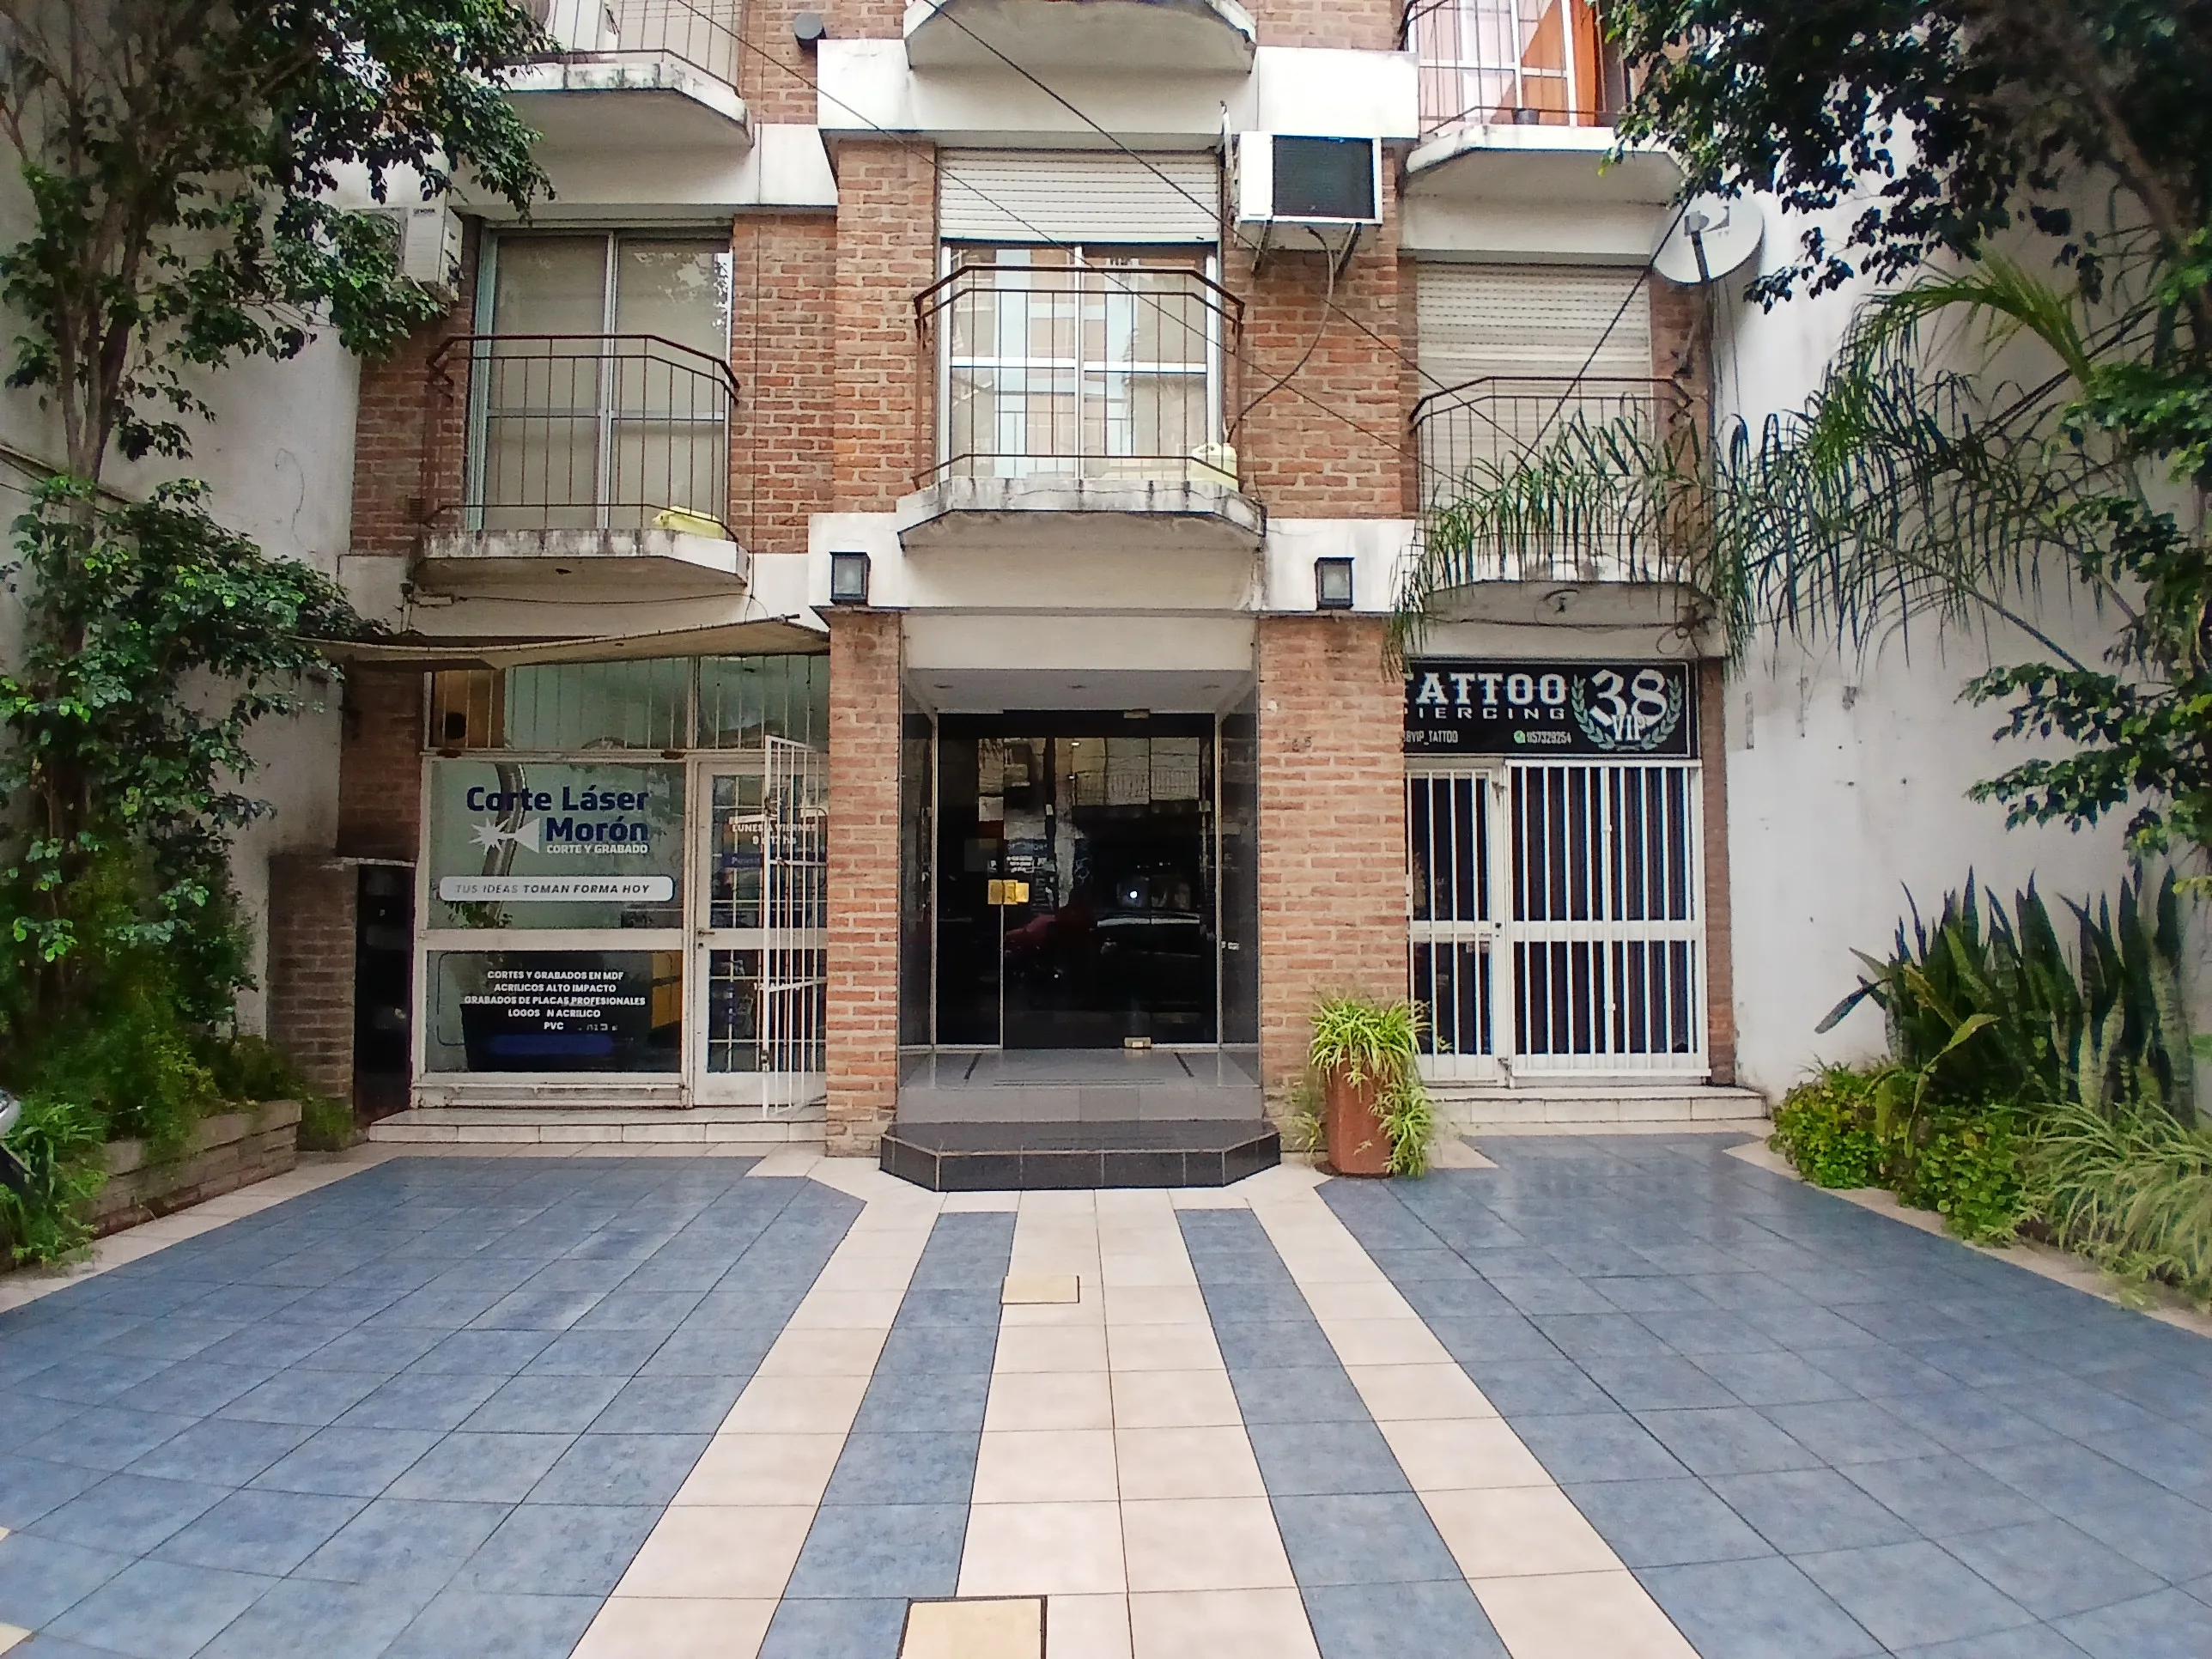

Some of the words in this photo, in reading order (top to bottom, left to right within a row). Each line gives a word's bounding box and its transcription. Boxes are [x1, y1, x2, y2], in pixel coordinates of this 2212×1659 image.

[1589, 669, 1668, 726] 38
[1404, 707, 1565, 720] IERCING
[1612, 714, 1647, 740] VIP
[466, 787, 552, 811] Corte
[562, 784, 649, 811] Láser
[545, 816, 648, 842] Morón
[546, 844, 582, 854] CORTE
[583, 845, 592, 854] Y
[593, 844, 648, 854] GRABADO
[456, 884, 478, 894] TUS
[483, 884, 519, 894] IDEAS
[523, 884, 570, 894] TOMAN
[573, 884, 618, 894] FORMA
[622, 884, 650, 894] HOY
[487, 970, 525, 979] CORTES
[534, 971, 587, 980] GRABADOS
[588, 971, 601, 980] EN
[603, 971, 624, 981] MDF
[545, 984, 571, 993] ALTO
[572, 984, 617, 993] IMPACTO
[464, 995, 517, 1005] GRABADOS
[518, 996, 531, 1005] DE
[532, 996, 569, 1005] PLACAS
[570, 996, 646, 1006] PROFESIONALES
[507, 1009, 541, 1018] LOGOS
[544, 1021, 564, 1030] PVC
